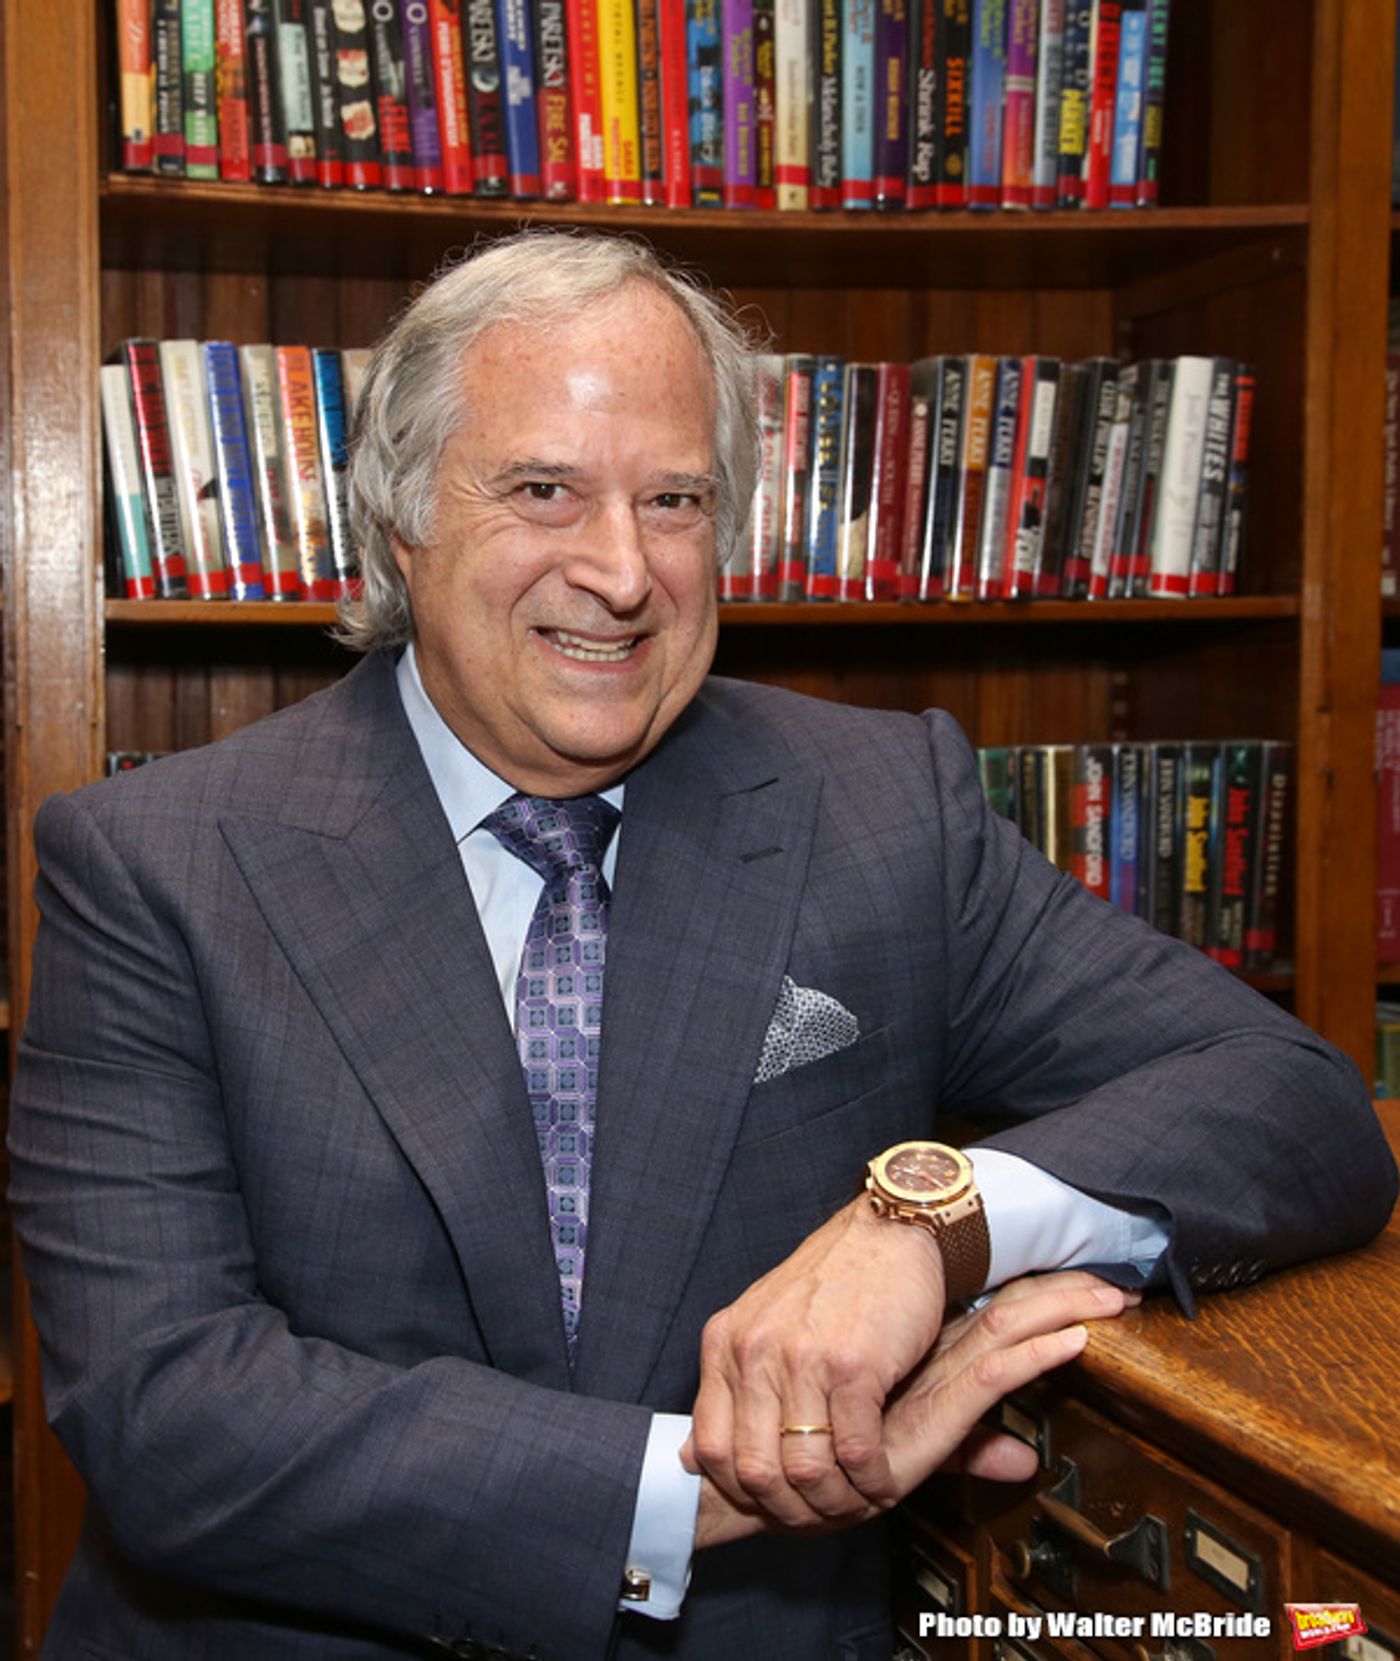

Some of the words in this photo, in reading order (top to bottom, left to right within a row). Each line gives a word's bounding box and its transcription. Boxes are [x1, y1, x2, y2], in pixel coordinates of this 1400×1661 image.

[545, 95, 566, 132] FIRE
[917, 69, 936, 138] Shrink
[945, 57, 965, 138] SIXKILL
[547, 137, 568, 164] SAL
[943, 369, 962, 412] ANNE
[974, 369, 993, 412] ANNE
[1001, 367, 1020, 413] ANNE
[939, 417, 958, 466] PERRY
[969, 415, 987, 465] PERRY
[995, 415, 1015, 465] PERRY
[1203, 397, 1232, 482] WHITES
[1085, 756, 1105, 802] JOHN
[1119, 786, 1138, 862] SANDFORD
[1158, 794, 1174, 859] SANDFORD
[1188, 796, 1210, 829] John
[1227, 787, 1250, 824] John
[1084, 804, 1105, 887] SANDFORD
[1184, 831, 1209, 893] Sandford
[1223, 828, 1249, 896] Sandford
